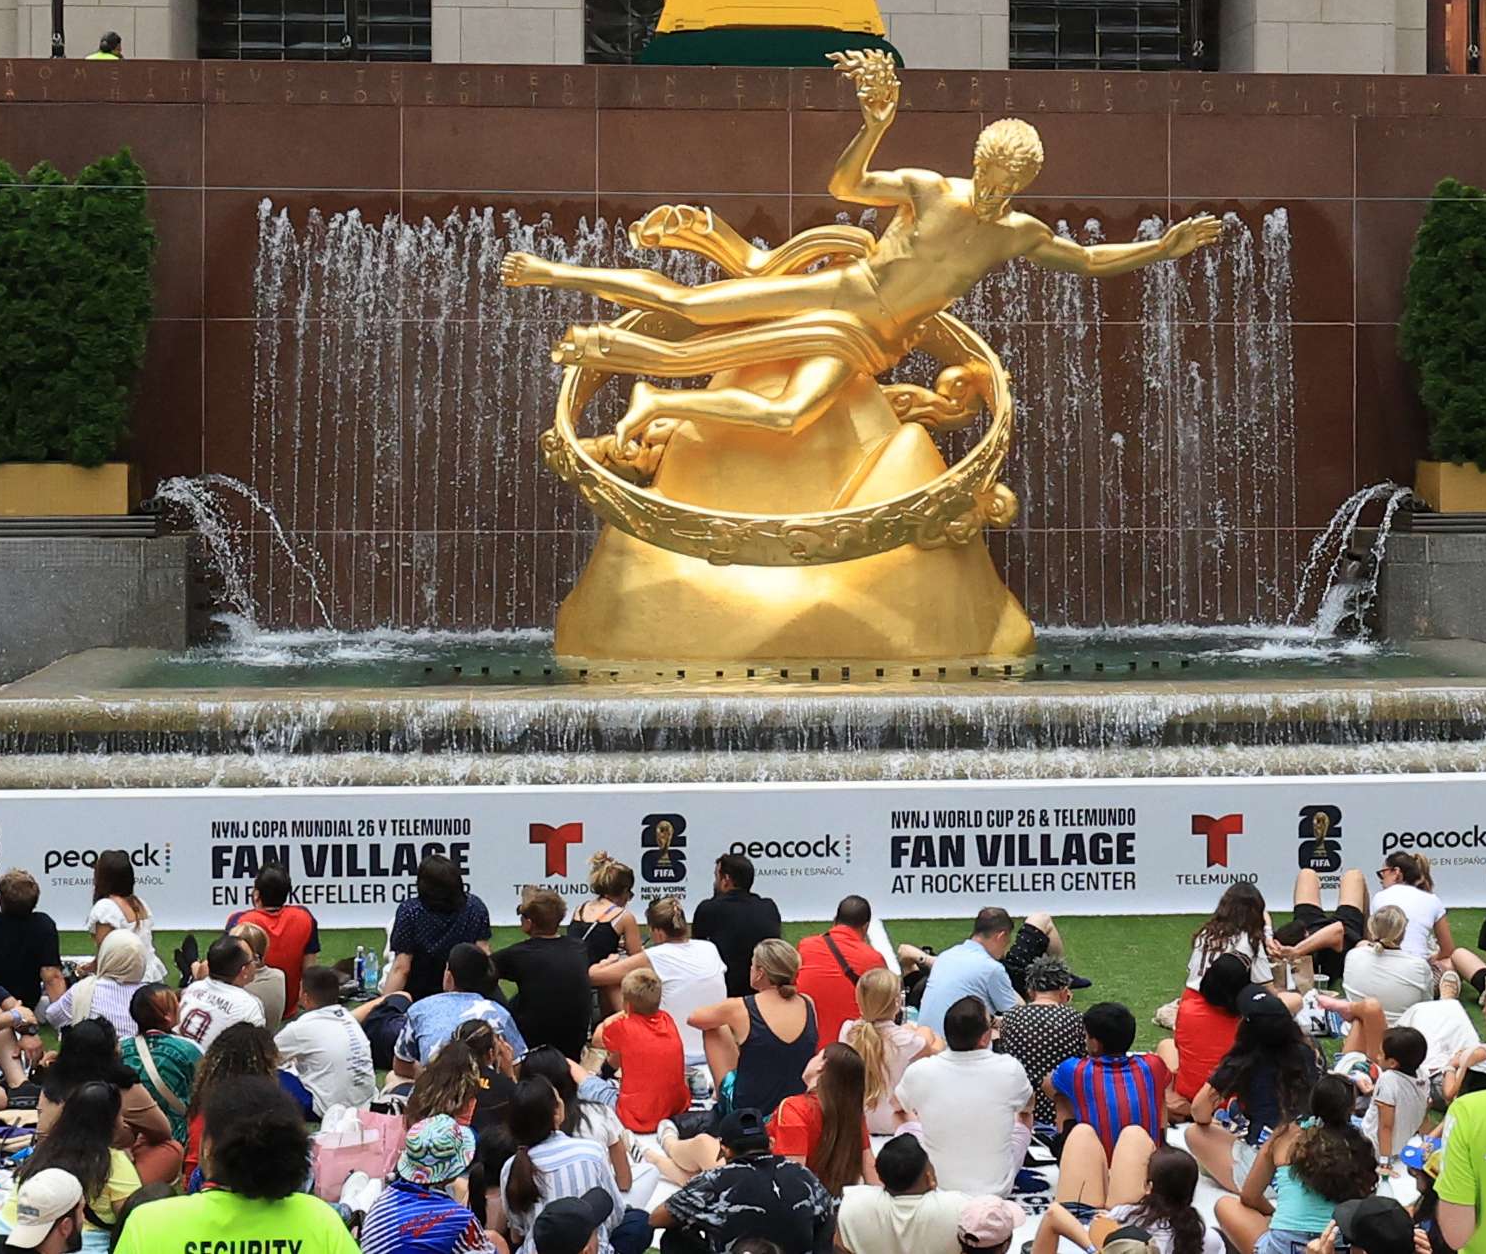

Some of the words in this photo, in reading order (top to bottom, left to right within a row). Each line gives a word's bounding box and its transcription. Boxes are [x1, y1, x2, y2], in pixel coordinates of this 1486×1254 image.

[212, 821, 249, 839] NYNJ
[252, 821, 288, 839] COPA
[291, 820, 354, 838] MUNDIAL
[358, 819, 375, 837] 26
[378, 820, 387, 836] Y
[389, 818, 471, 837] TELEMUNDO
[891, 809, 930, 830] NYNJ
[932, 809, 983, 829] WORLD
[986, 809, 1014, 828] CUP
[1017, 809, 1035, 828] 26
[1039, 808, 1050, 828] &
[1053, 807, 1136, 827] TELEMUNDO
[729, 833, 841, 859] peacock
[891, 834, 970, 869] FAN
[976, 832, 1136, 868] VILLAGE
[212, 844, 289, 880] FAN
[804, 864, 844, 876] ESPAÑOL
[1310, 858, 1331, 868] FIFA
[653, 869, 675, 878] FIFA
[891, 875, 916, 895] AT
[921, 873, 1055, 894] ROCKEFELLER
[1061, 871, 1136, 891] CENTER
[1176, 873, 1258, 886] TELEMUNDO
[212, 887, 238, 906] EN
[246, 883, 387, 905] RKEFELLER
[641, 886, 661, 894] NEW
[663, 886, 687, 894] YORK
[184, 1240, 303, 1254] SECURITY
